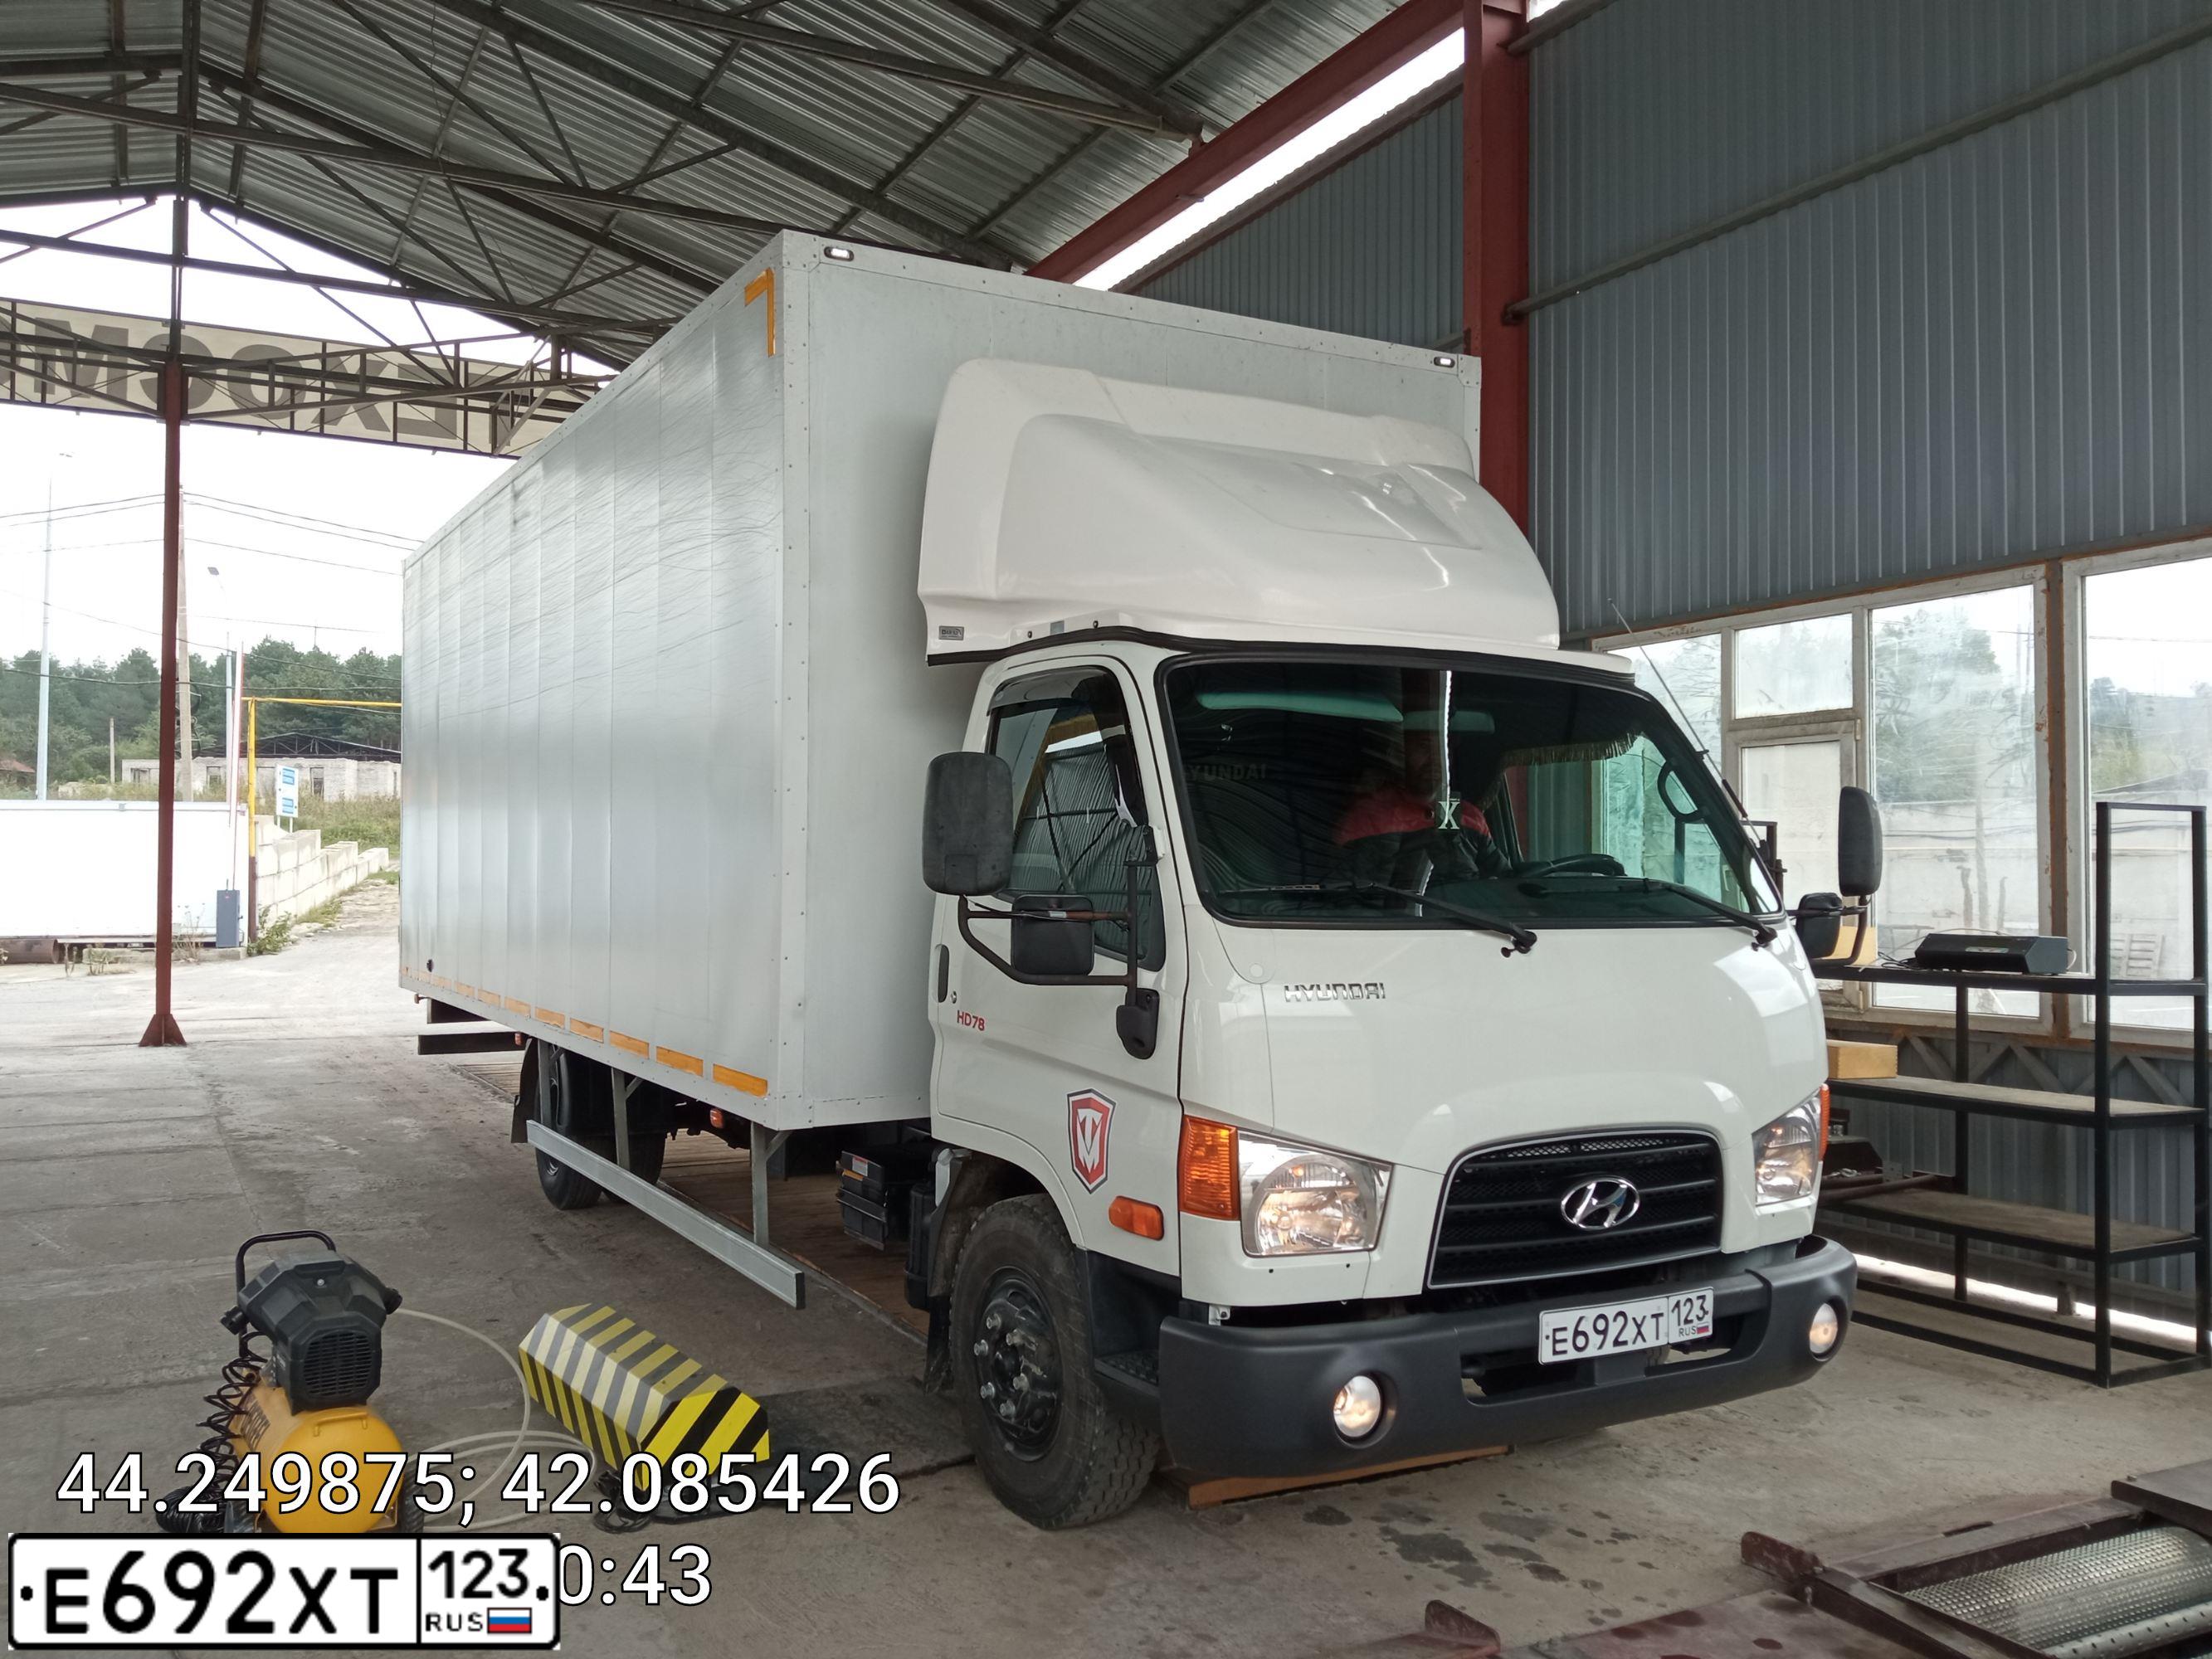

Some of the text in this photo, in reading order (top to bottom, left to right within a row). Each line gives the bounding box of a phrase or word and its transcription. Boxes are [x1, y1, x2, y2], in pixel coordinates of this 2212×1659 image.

[1186, 763, 1267, 781] YUNDAI
[1284, 982, 1386, 1002] HYUNDAI
[956, 1009, 986, 1032] HD78
[1671, 1294, 1708, 1327] 123
[1678, 1326, 1697, 1337] RUS
